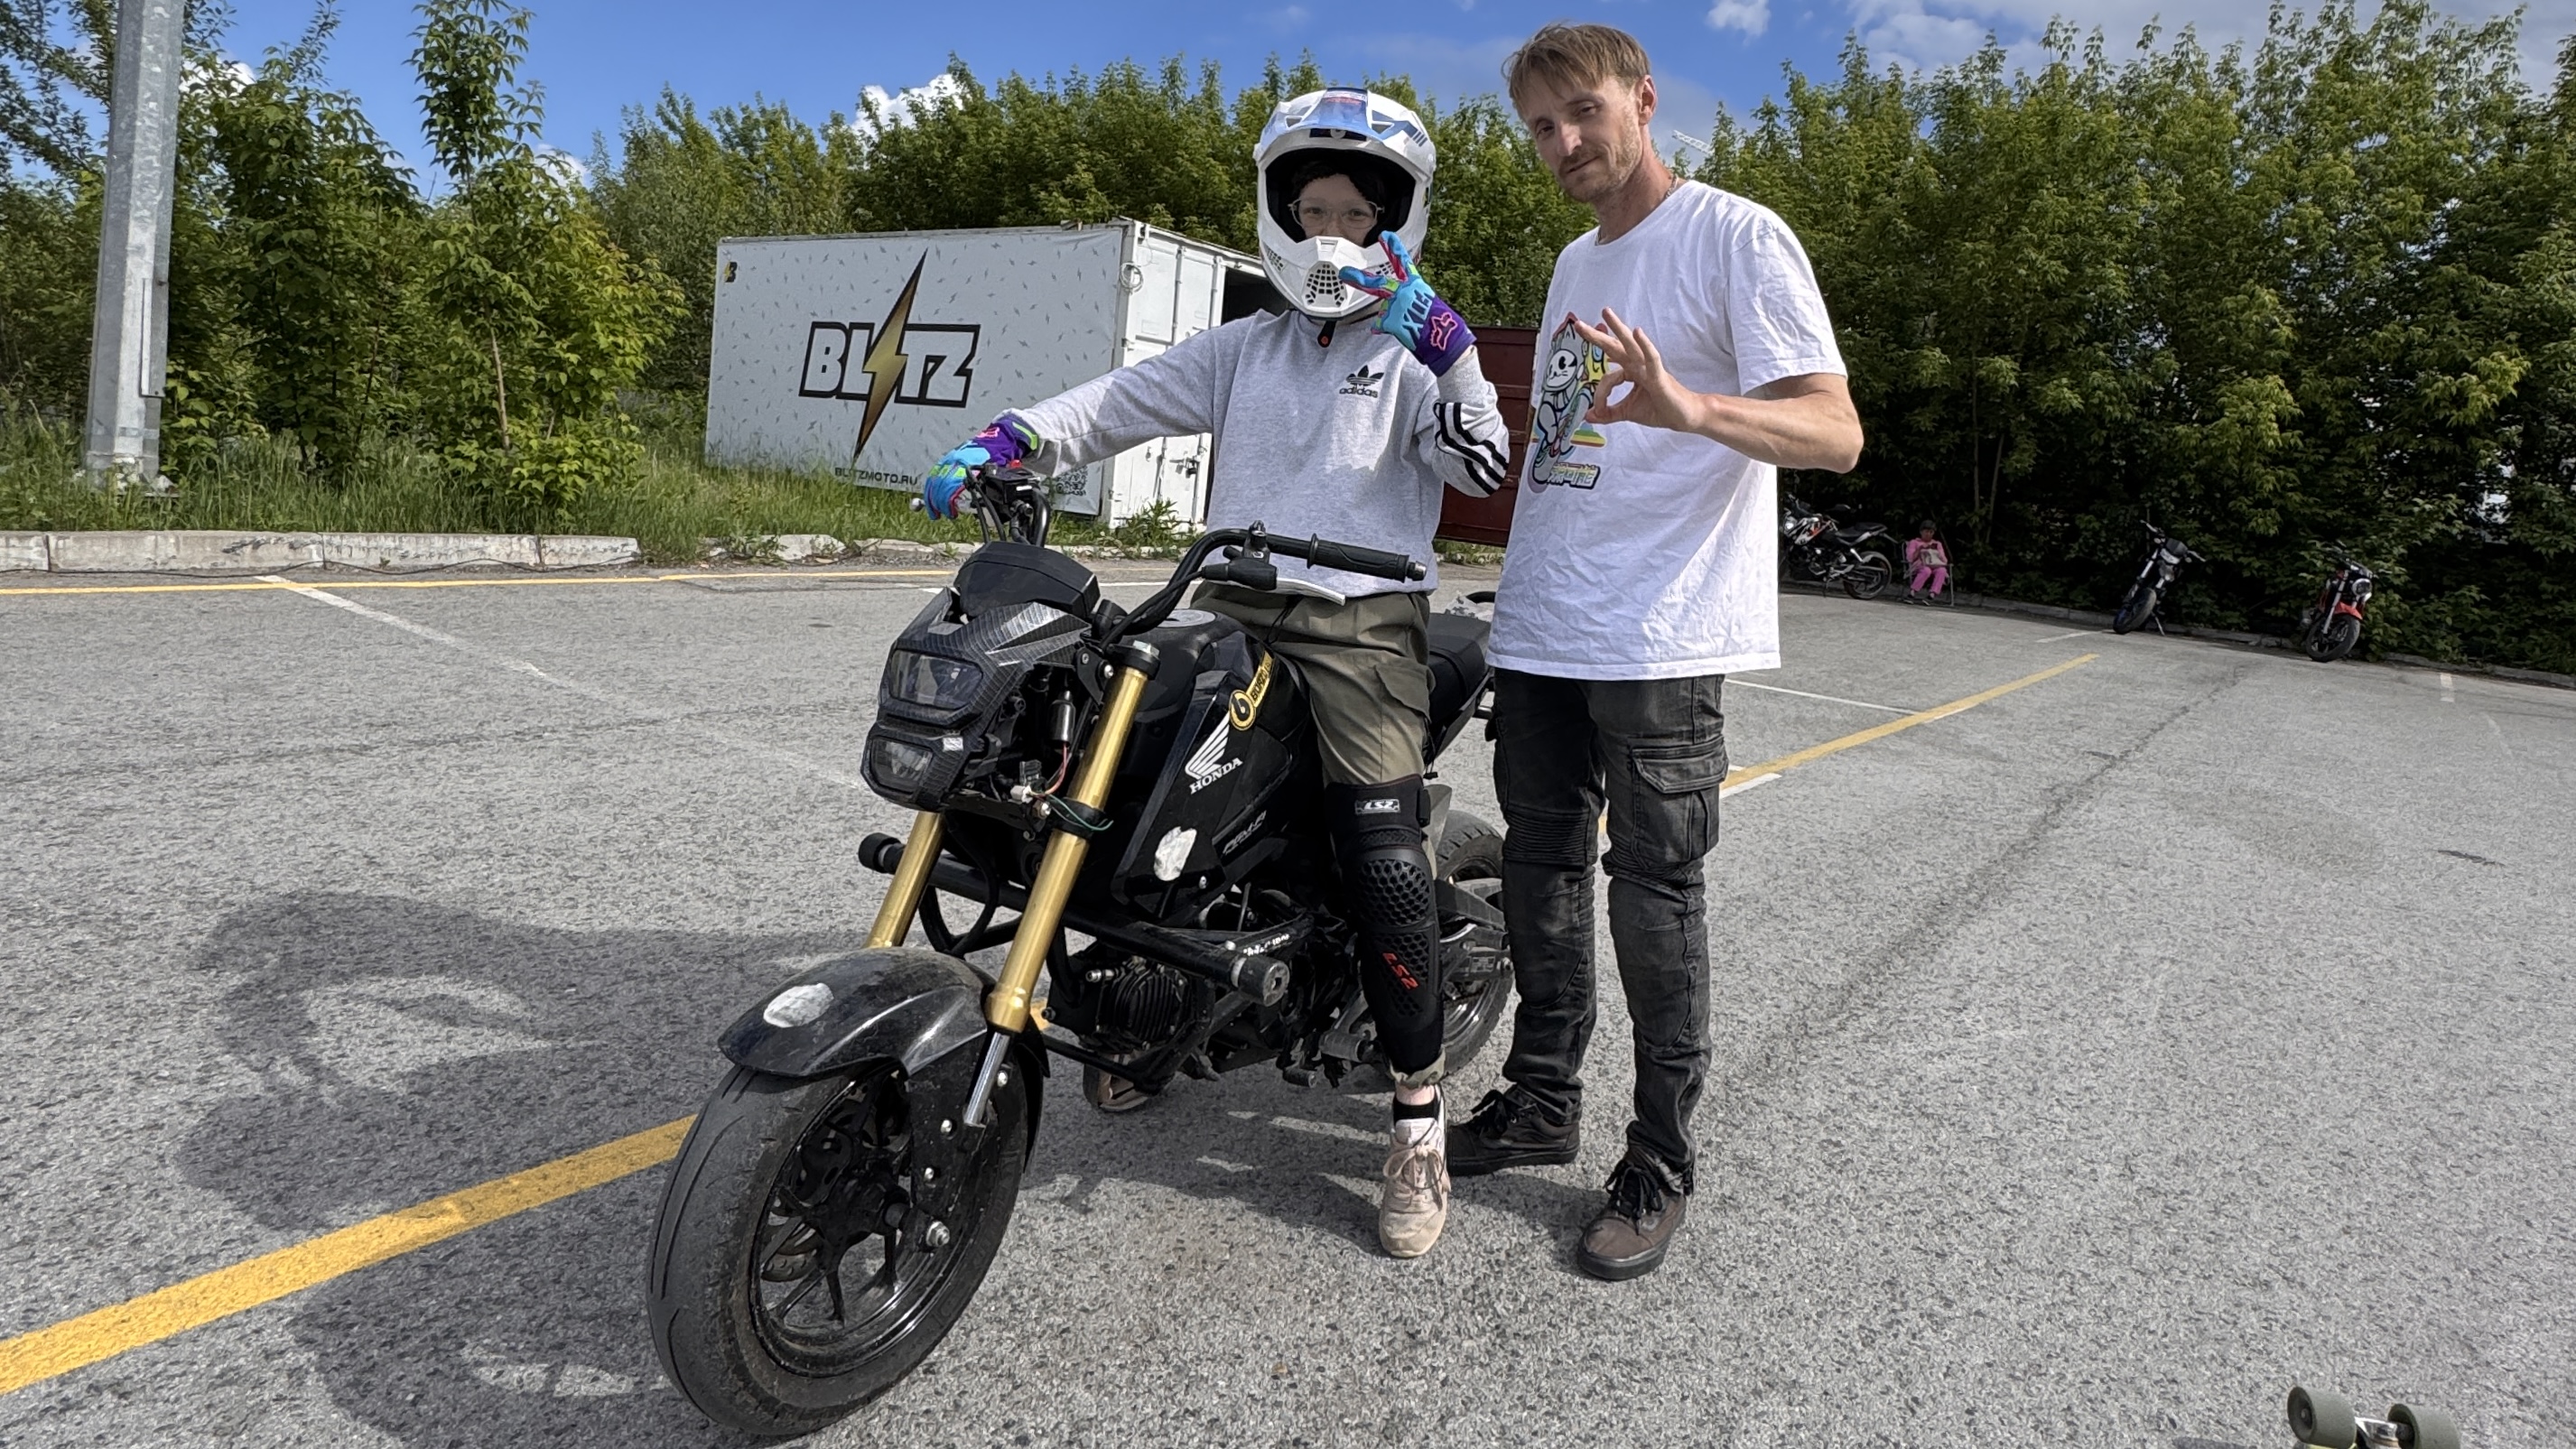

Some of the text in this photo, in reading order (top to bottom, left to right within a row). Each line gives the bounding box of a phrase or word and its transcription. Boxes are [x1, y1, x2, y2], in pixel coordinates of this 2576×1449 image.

[798, 320, 981, 409] BLITZ
[1339, 385, 1378, 398] adidas
[1189, 757, 1243, 794] HONDA
[1362, 800, 1396, 811] LS2
[1382, 952, 1418, 989] LS2
